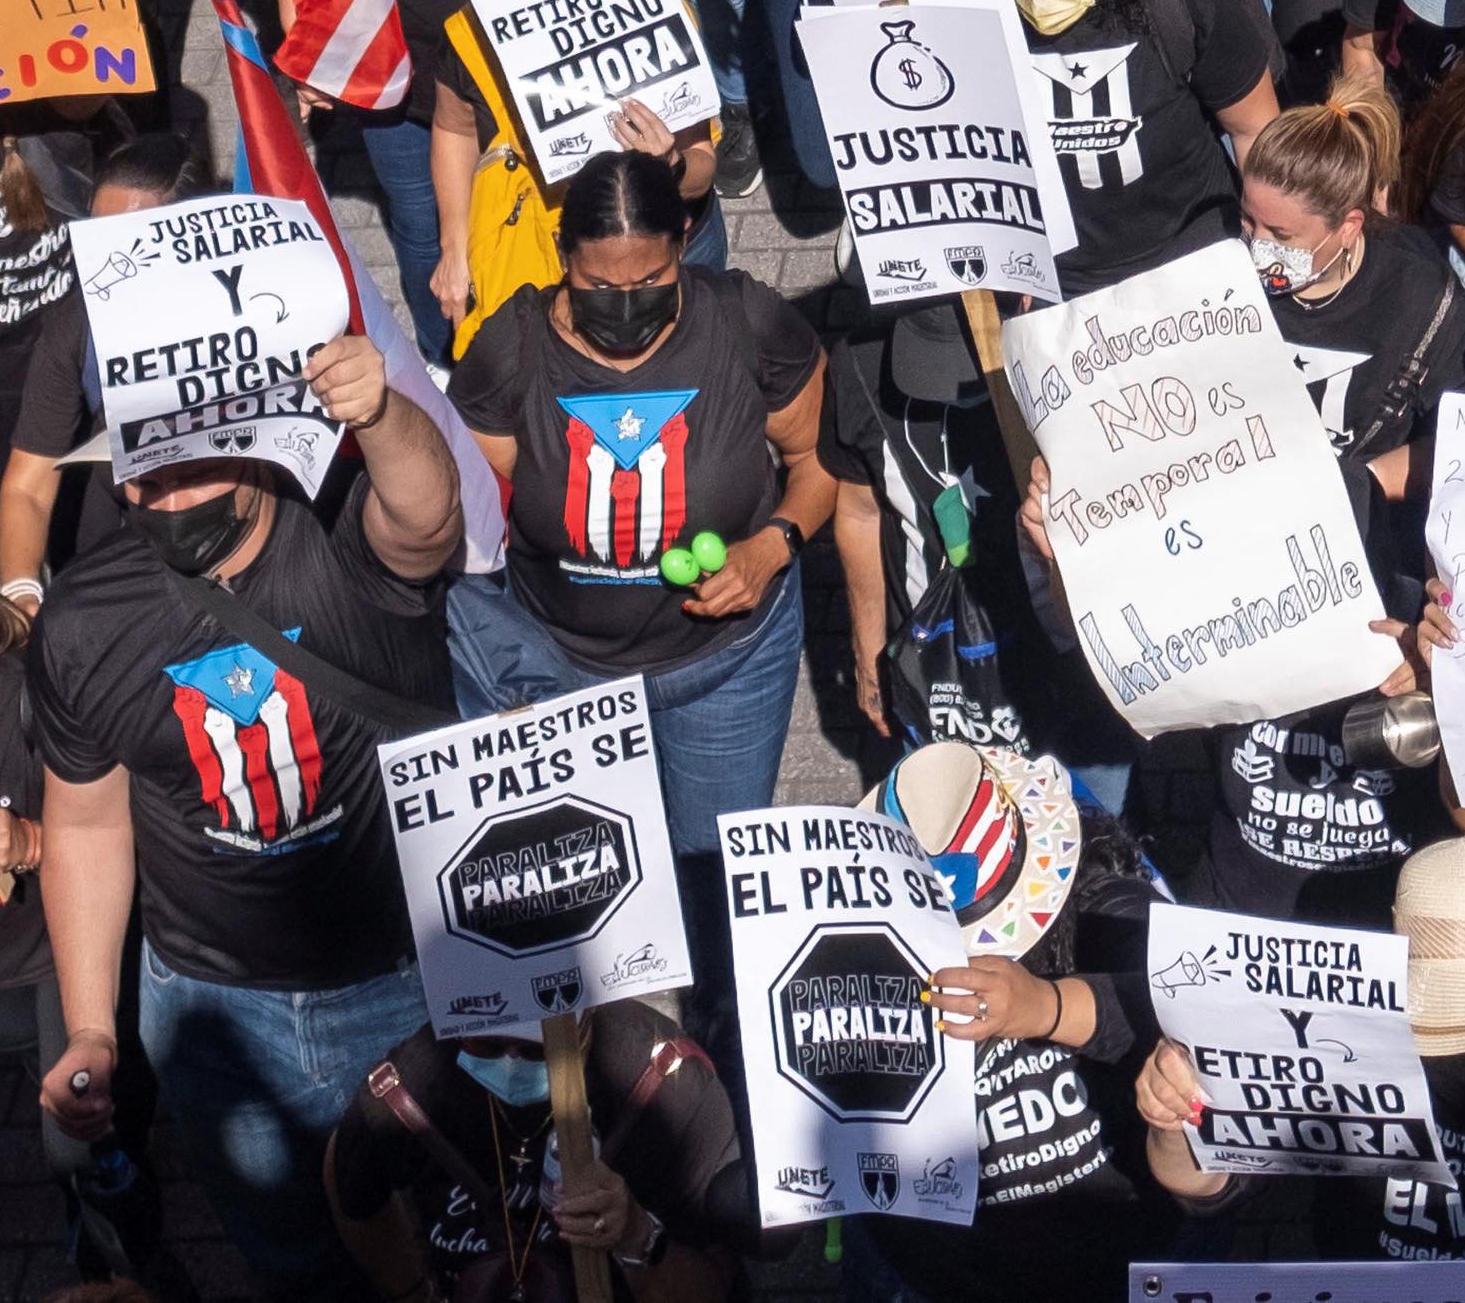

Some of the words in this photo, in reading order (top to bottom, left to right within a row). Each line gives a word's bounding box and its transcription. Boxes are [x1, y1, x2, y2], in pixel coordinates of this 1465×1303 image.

[834, 125, 1032, 171] JUSTICIA
[151, 202, 278, 245] JUSTICIA
[851, 186, 1044, 233] SALARIAL
[173, 220, 323, 262] SALARIAL
[214, 268, 243, 317] Y
[107, 327, 259, 390] RETIRO
[1012, 356, 1070, 432] La
[1073, 288, 1262, 386] educación
[1089, 374, 1196, 453] NO
[1209, 384, 1246, 418] es
[1046, 414, 1276, 547] Temporal
[1164, 519, 1204, 554] es
[1078, 526, 1362, 702] Interminable
[389, 744, 457, 787] SIN
[473, 691, 638, 764] MAESTROS
[396, 789, 452, 833] EL
[474, 750, 575, 815] PAÍS
[589, 725, 650, 768] SE
[728, 824, 792, 859] SIN
[804, 818, 929, 859] MAESTROS
[462, 848, 620, 906] PARALIZA
[732, 872, 788, 918] EL
[801, 854, 892, 912] PAÍS
[1227, 932, 1362, 973] JUSTICIA
[1245, 961, 1405, 1012] SALARIAL
[793, 1007, 929, 1045] PARALIZA
[1280, 1011, 1313, 1049] Y
[1243, 1079, 1405, 1115] DIGNO
[1212, 1112, 1415, 1159] AHORA
